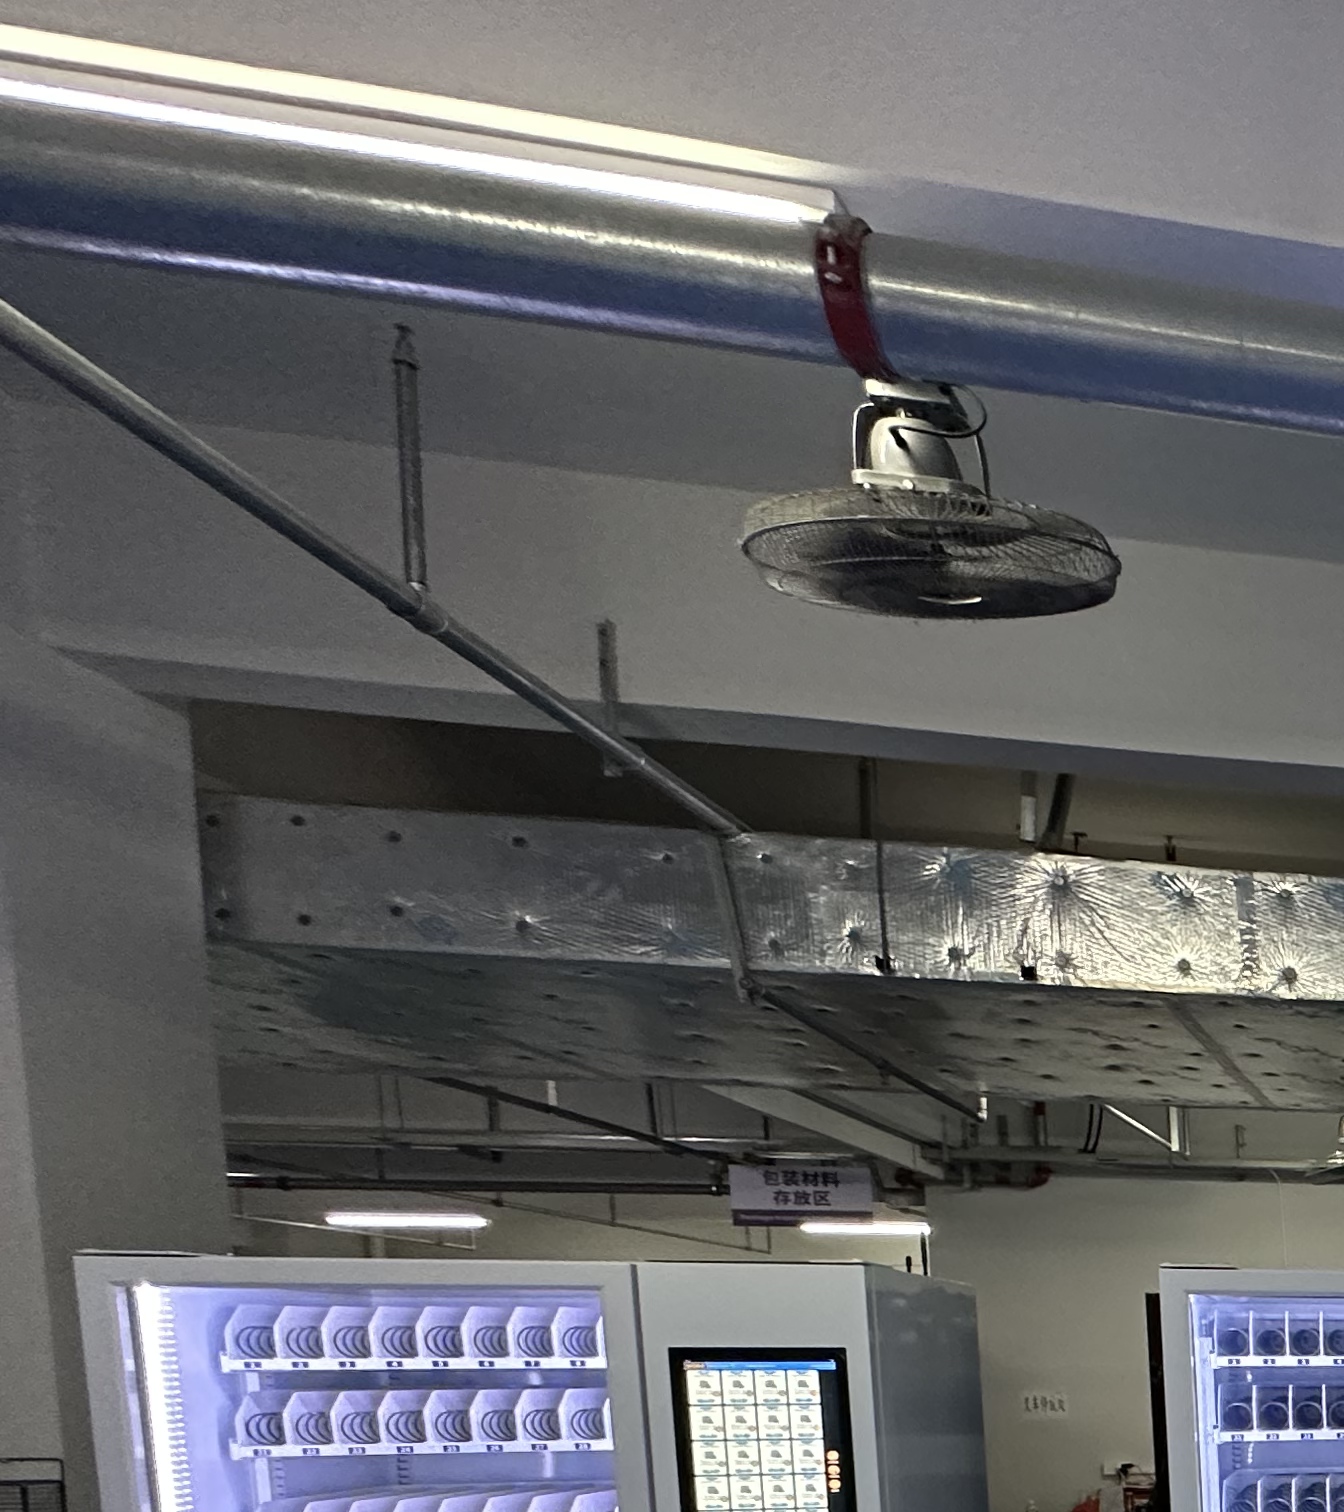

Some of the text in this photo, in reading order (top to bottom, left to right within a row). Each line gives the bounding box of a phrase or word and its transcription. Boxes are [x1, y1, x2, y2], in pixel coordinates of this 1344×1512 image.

[763, 1170, 840, 1188] 包装材料
[773, 1190, 832, 1207] 存放区
